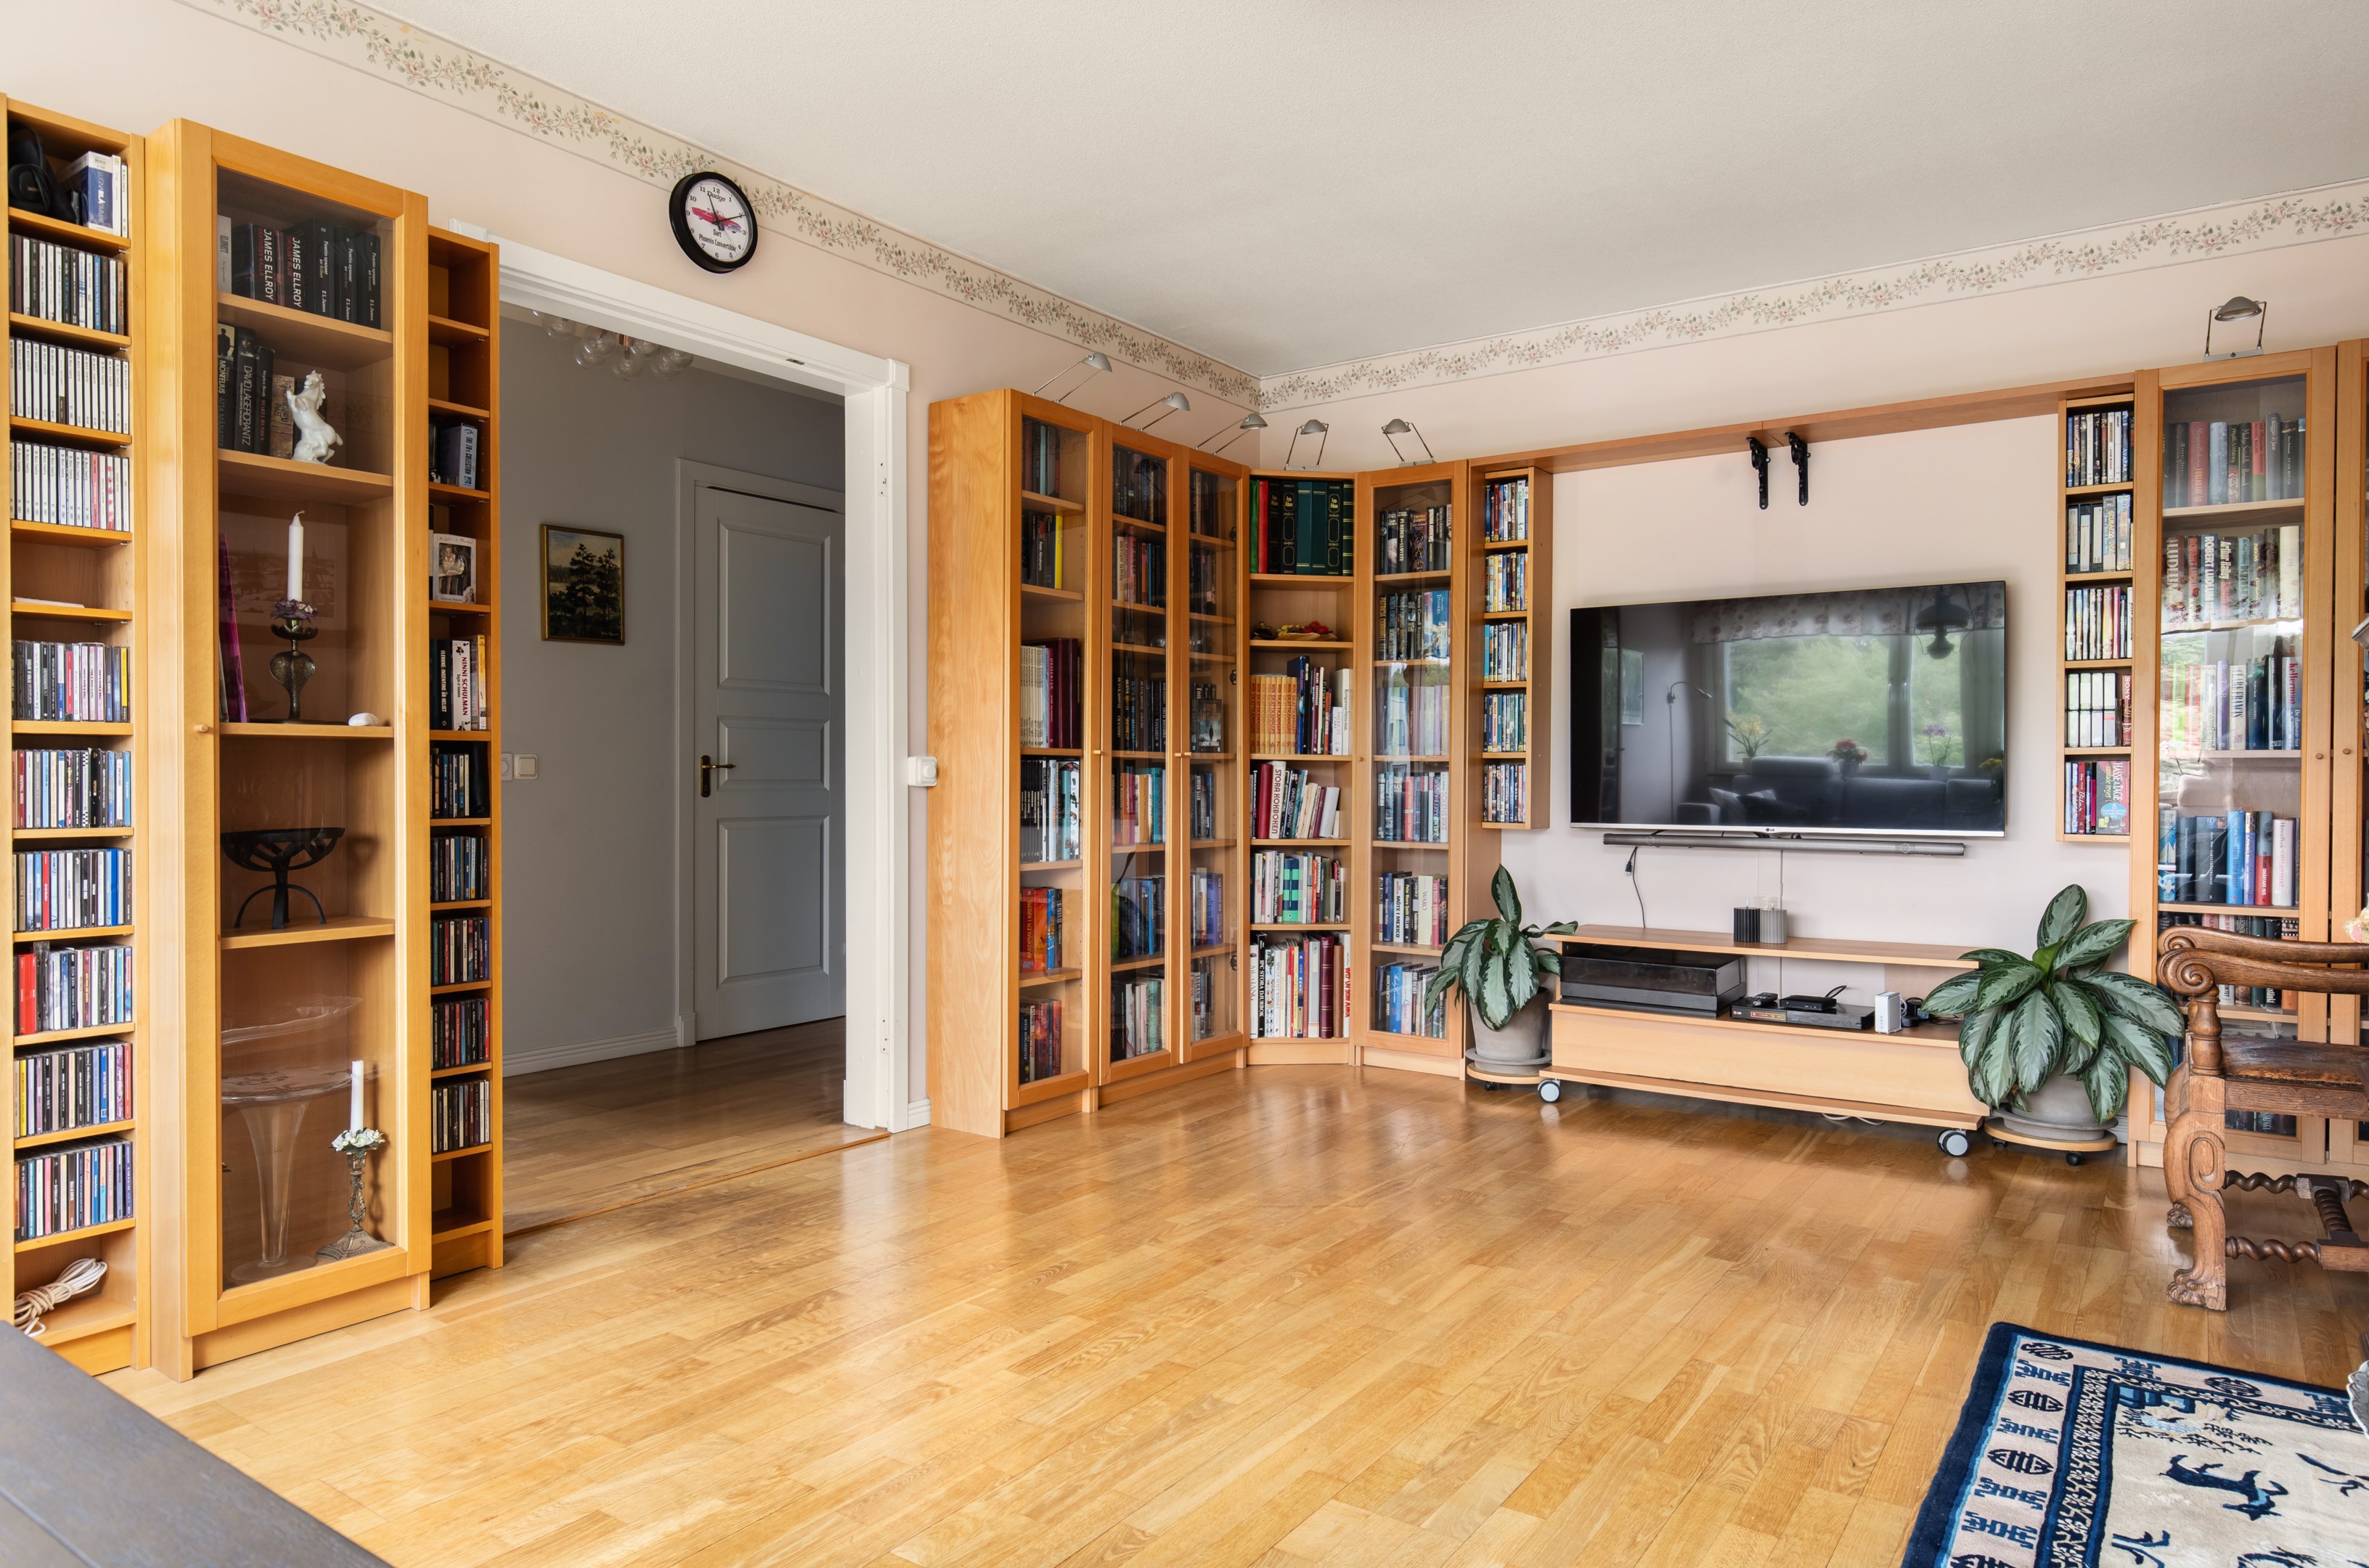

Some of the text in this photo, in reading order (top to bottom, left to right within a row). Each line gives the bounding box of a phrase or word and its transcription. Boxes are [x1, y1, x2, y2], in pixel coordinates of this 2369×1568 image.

[707, 191, 725, 202] Dodge
[699, 234, 735, 251] Phoenix Convertible
[263, 229, 274, 301] JAMES ELLROY
[292, 237, 301, 308] JAMES ELLROY
[242, 366, 253, 446] DAVID LAGERCRANTZ
[2166, 544, 2179, 592] LUDLUM
[2189, 538, 2198, 566] ROBERT
[2204, 536, 2214, 601] ROBERT LUDLUM
[2219, 561, 2232, 579] Hailey
[2220, 541, 2232, 561] Arthur
[2231, 669, 2243, 718] CLARE FRANCIS
[2288, 663, 2299, 704] Kellerman
[1204, 703, 1217, 711] DAVID
[1271, 769, 1282, 834] STORA KOKBOKEN
[2113, 762, 2123, 801] HASSE&TAGE
